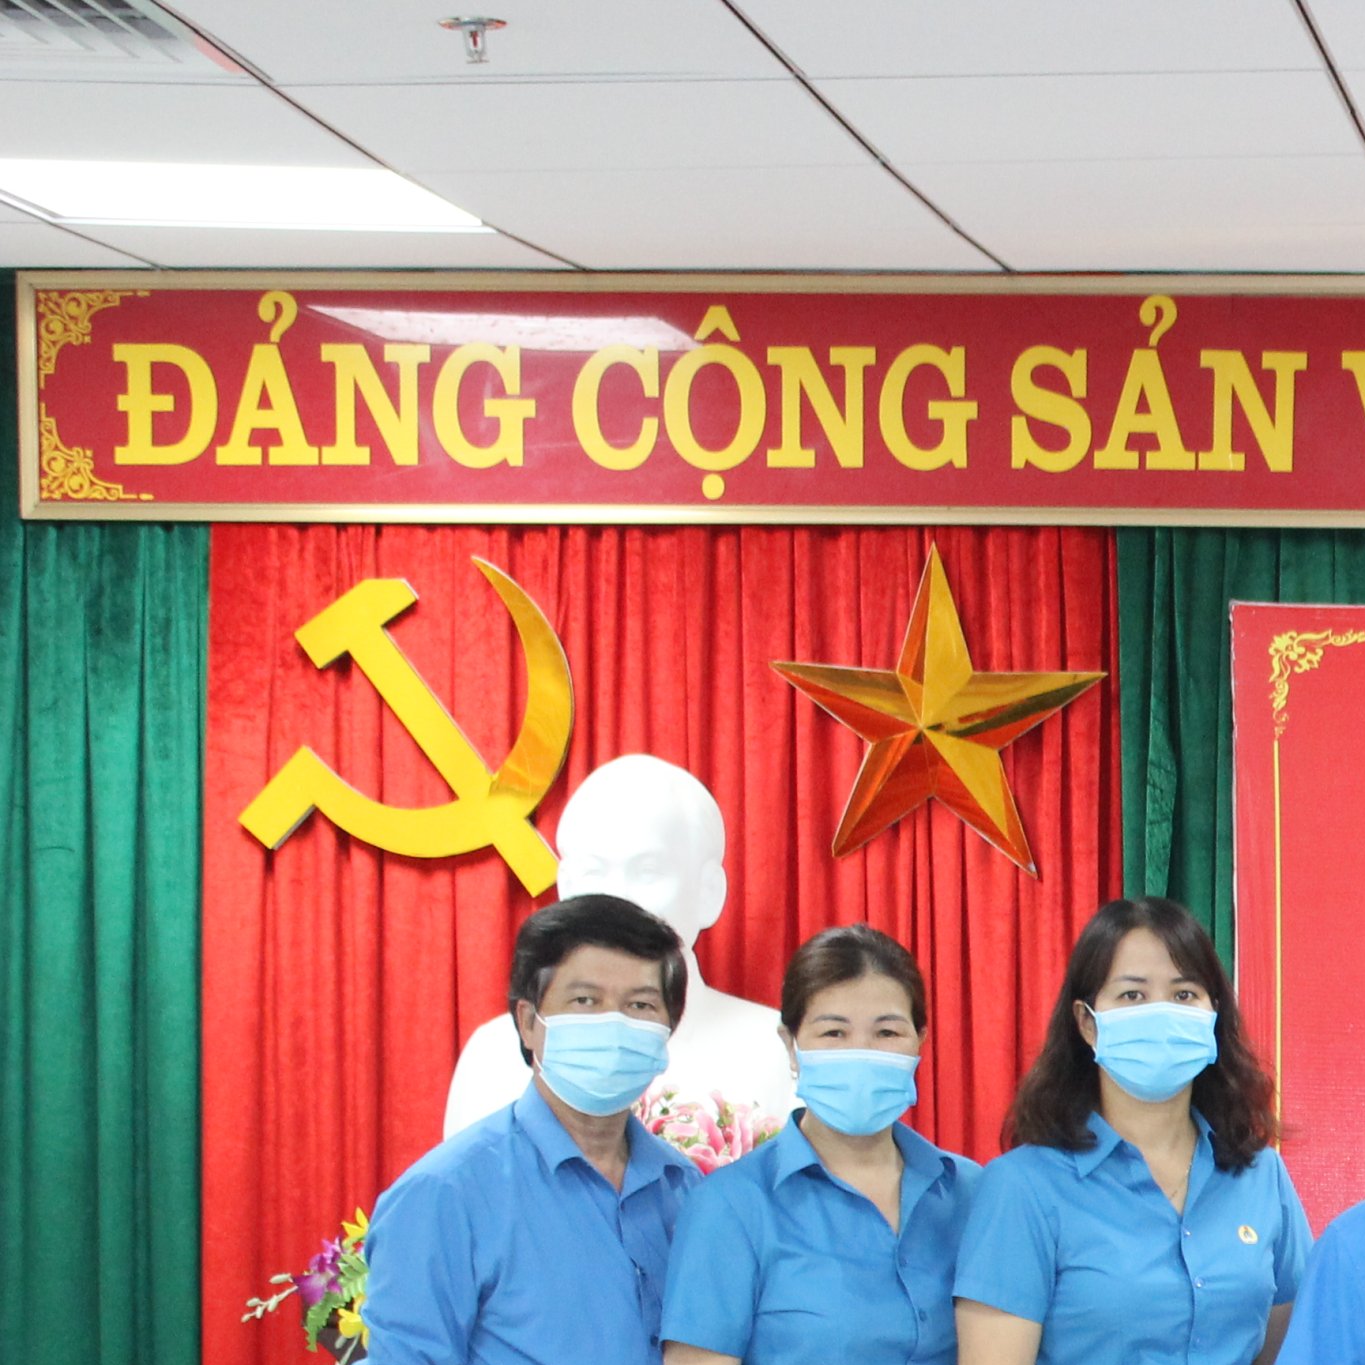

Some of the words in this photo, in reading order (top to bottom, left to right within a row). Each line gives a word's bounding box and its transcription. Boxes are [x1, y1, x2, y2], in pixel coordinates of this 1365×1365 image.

[112, 290, 537, 470] ĐẢNG
[571, 305, 979, 500] CỘNG
[1009, 294, 1309, 474] SẢN
